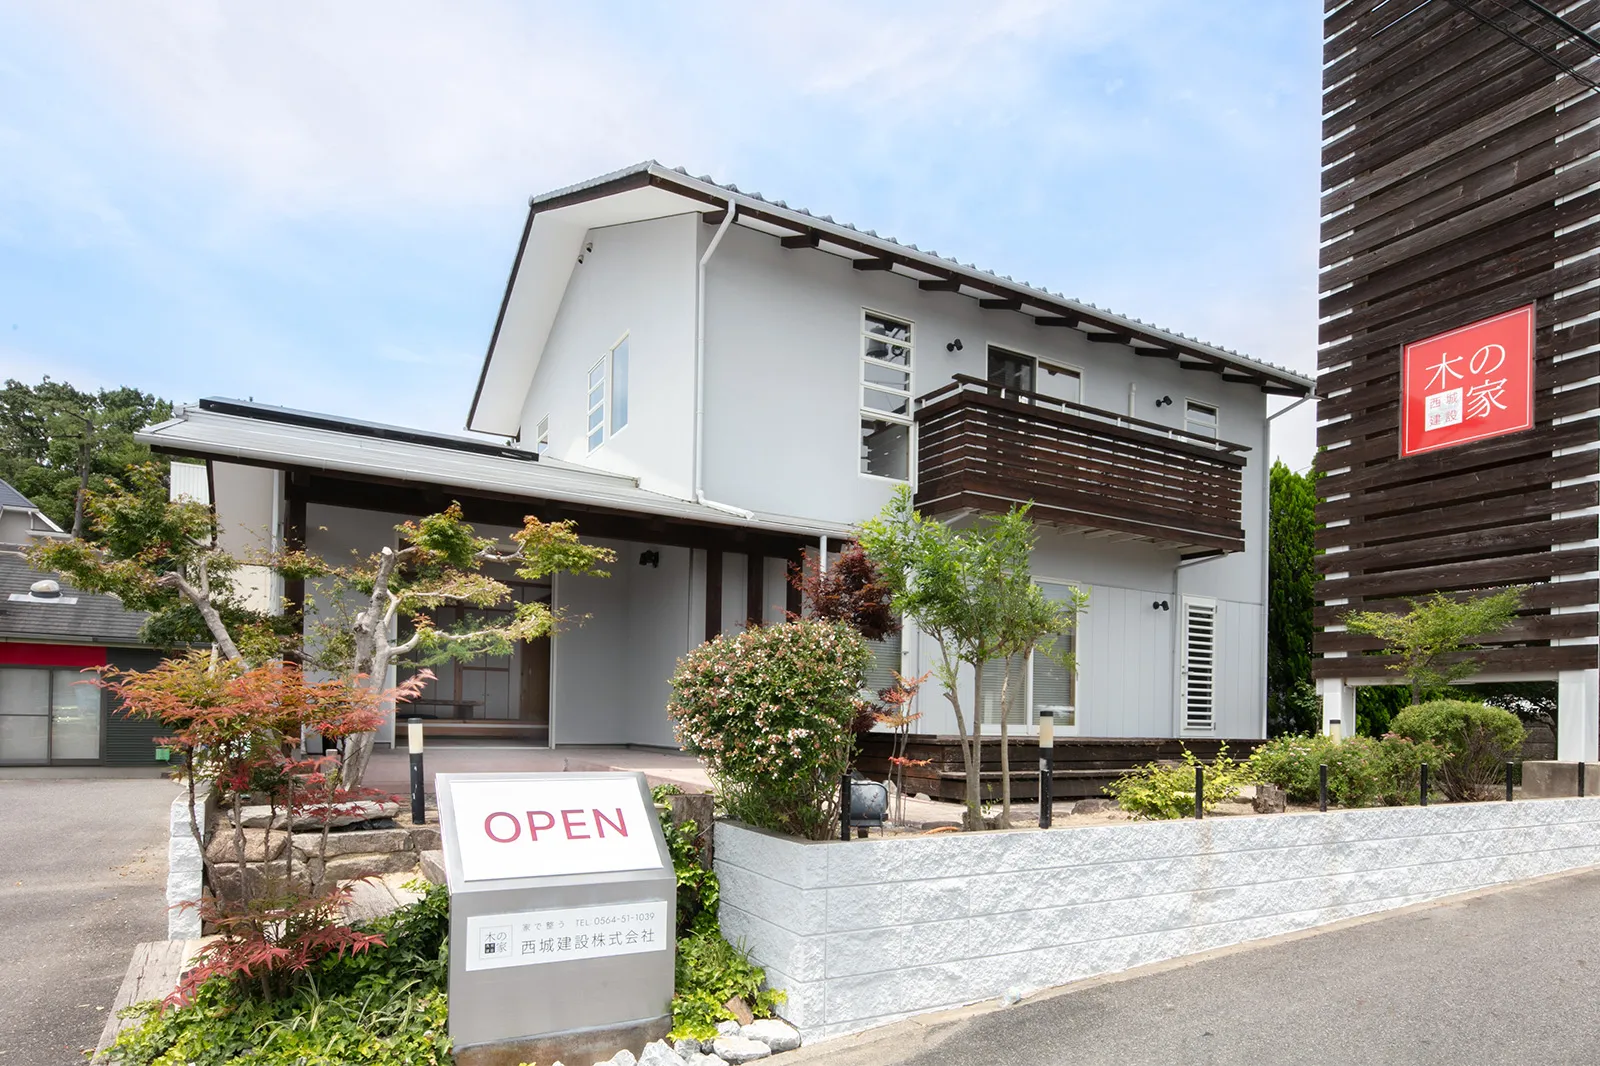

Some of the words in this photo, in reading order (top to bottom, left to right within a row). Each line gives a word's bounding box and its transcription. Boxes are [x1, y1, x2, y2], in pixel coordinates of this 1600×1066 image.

[484, 808, 628, 843] OPEN
[593, 912, 655, 926] 0564-51-1039
[521, 928, 655, 955] 西城建設株式会社
